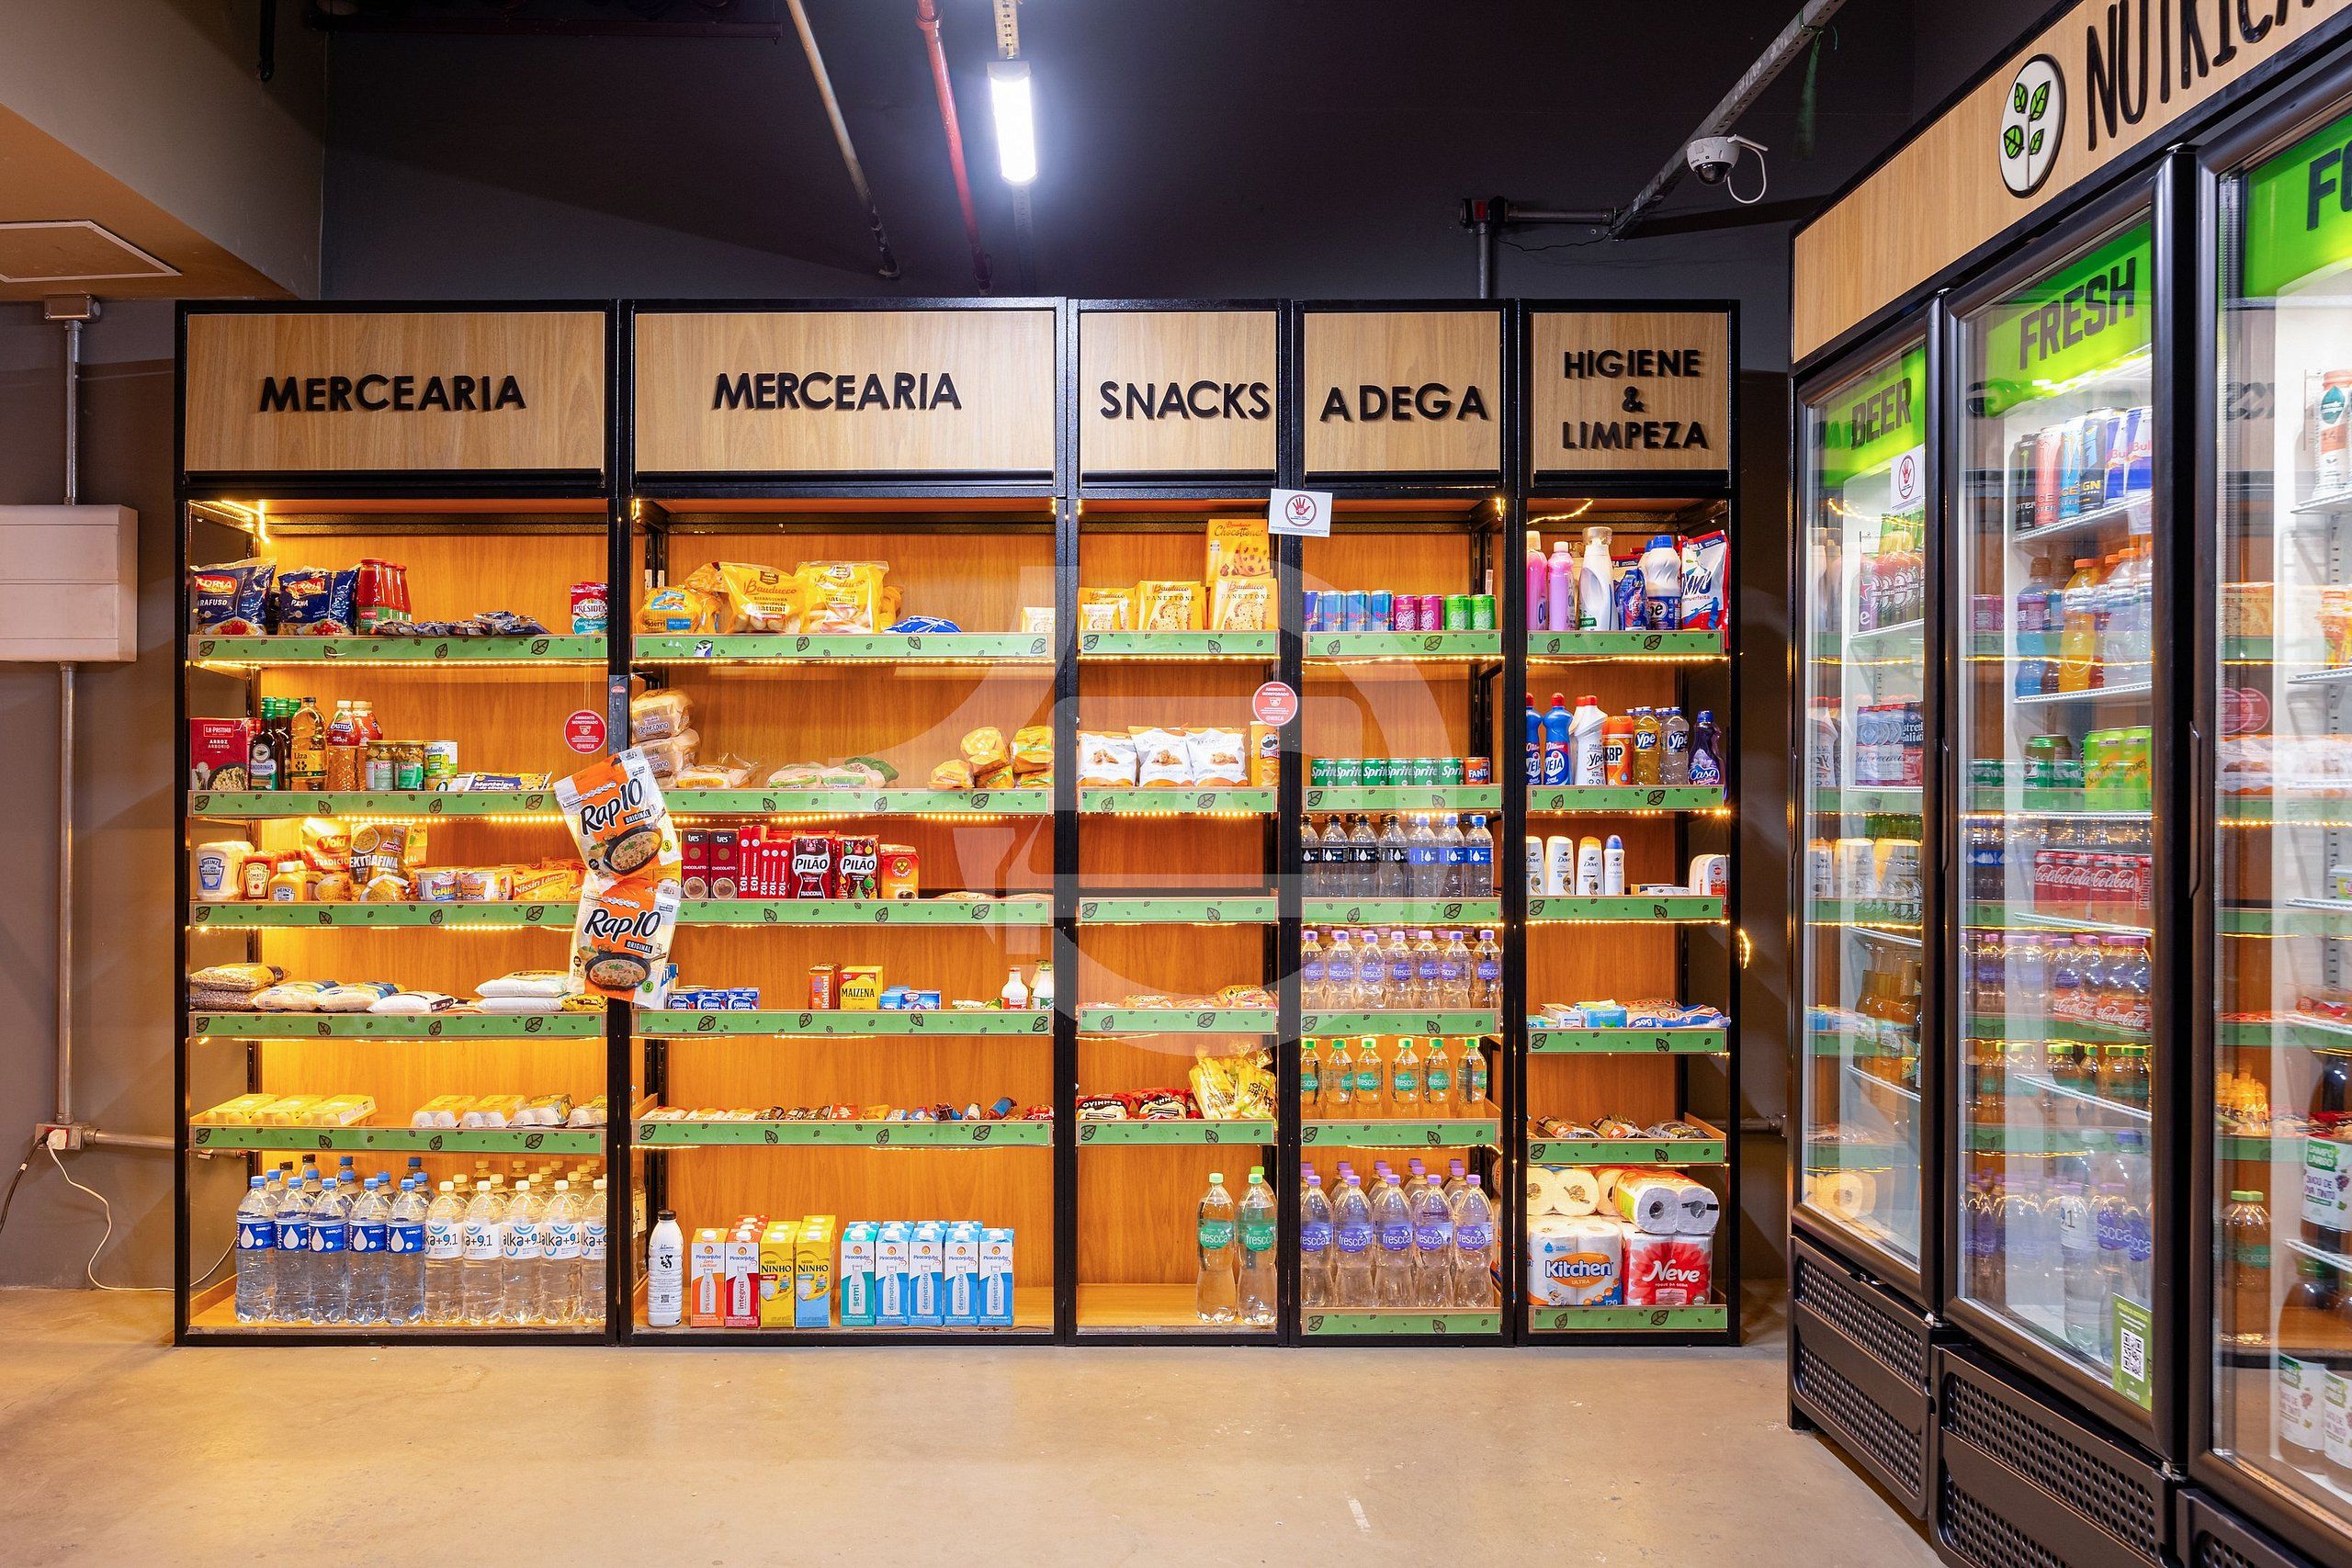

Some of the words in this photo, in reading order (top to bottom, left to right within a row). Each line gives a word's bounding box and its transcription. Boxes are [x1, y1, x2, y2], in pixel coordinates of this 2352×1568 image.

[2020, 257, 2136, 370] FRESH
[1565, 349, 1701, 378] HIGIENE
[259, 374, 526, 412] MERCEARIA
[711, 372, 961, 411] MERCEARIA
[1622, 387, 1645, 412] &
[1100, 380, 1272, 420] SNACKS
[1319, 383, 1489, 422] ADEGA
[1851, 378, 1911, 451] BEER
[1562, 422, 1709, 450] LIMPEZA
[744, 580, 797, 595] Bauducco
[1152, 583, 1191, 594] Bauducco
[1690, 769, 1716, 779] Casa
[580, 777, 644, 836] Rap10
[625, 809, 651, 824] ORIGINAL
[322, 837, 346, 849] Yoki
[350, 854, 398, 869] EXTRAFINA
[795, 857, 828, 870] PILÃO
[842, 858, 876, 871] PILÃO
[514, 880, 541, 895] Nissin
[583, 908, 661, 943] Rap10
[627, 940, 651, 953] ORIGINAL
[842, 988, 875, 998] MAIZENA
[1339, 1231, 1367, 1247] frescca
[1383, 1231, 1412, 1247] frescca
[1457, 1231, 1487, 1247] frescca
[762, 1264, 792, 1273] NINHO
[798, 1264, 829, 1273] NINHO
[1544, 1261, 1611, 1278] Kitchen
[1644, 1259, 1700, 1282] Neve
